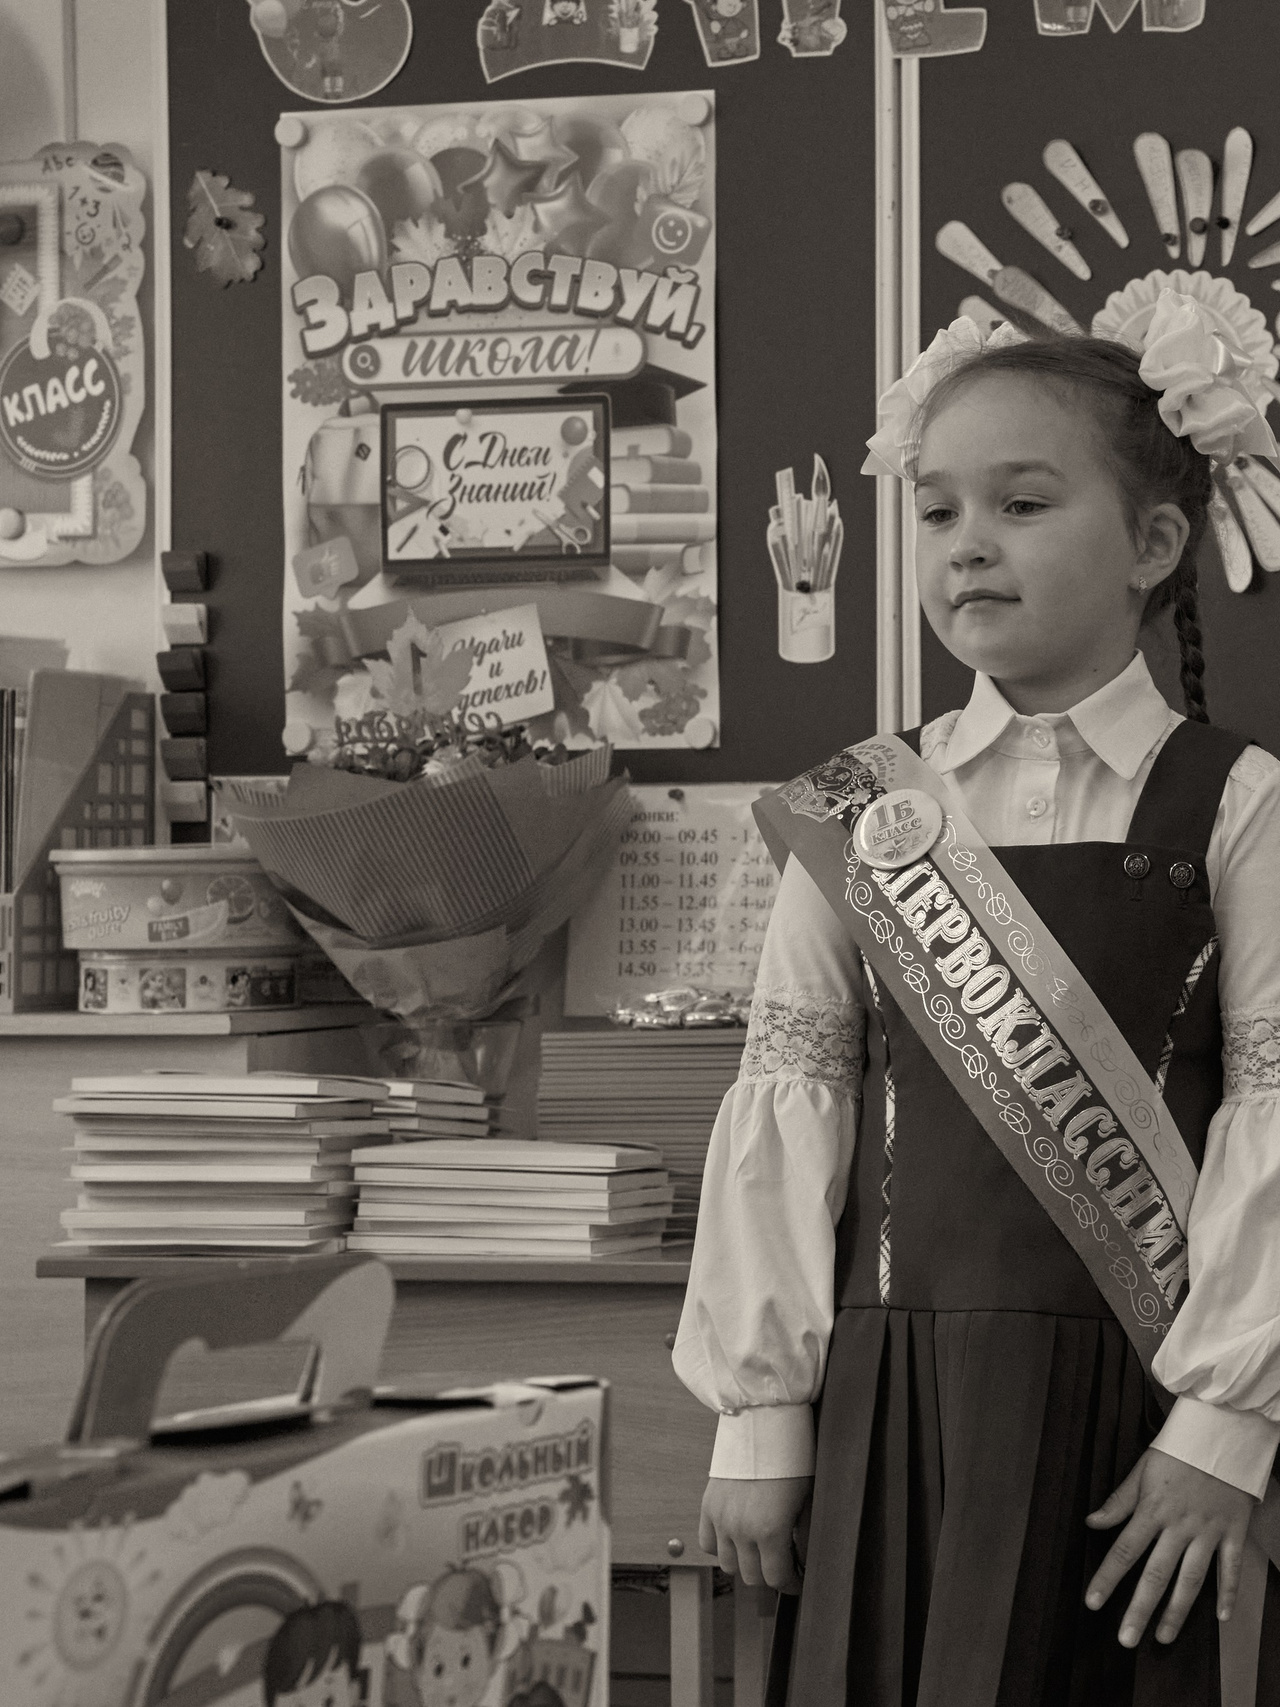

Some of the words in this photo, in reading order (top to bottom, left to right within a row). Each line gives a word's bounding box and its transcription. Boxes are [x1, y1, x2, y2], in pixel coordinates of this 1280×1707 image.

[293, 250, 706, 359] ЗДРАВСТВУЙ,
[401, 328, 600, 377] школа!
[3, 358, 106, 427] КЛАСС
[443, 433, 467, 471] С
[464, 431, 551, 469] Днем
[426, 472, 557, 520] Знаний!
[630, 811, 679, 823] вонки:
[621, 830, 660, 843] 09.00
[870, 816, 922, 846] КЛАСС
[620, 852, 660, 865] 09.55
[621, 874, 660, 888] 11.00
[621, 896, 658, 910] 11.55
[620, 918, 658, 932] 13.00
[618, 940, 656, 954] 13.55
[618, 962, 656, 976] 14.50
